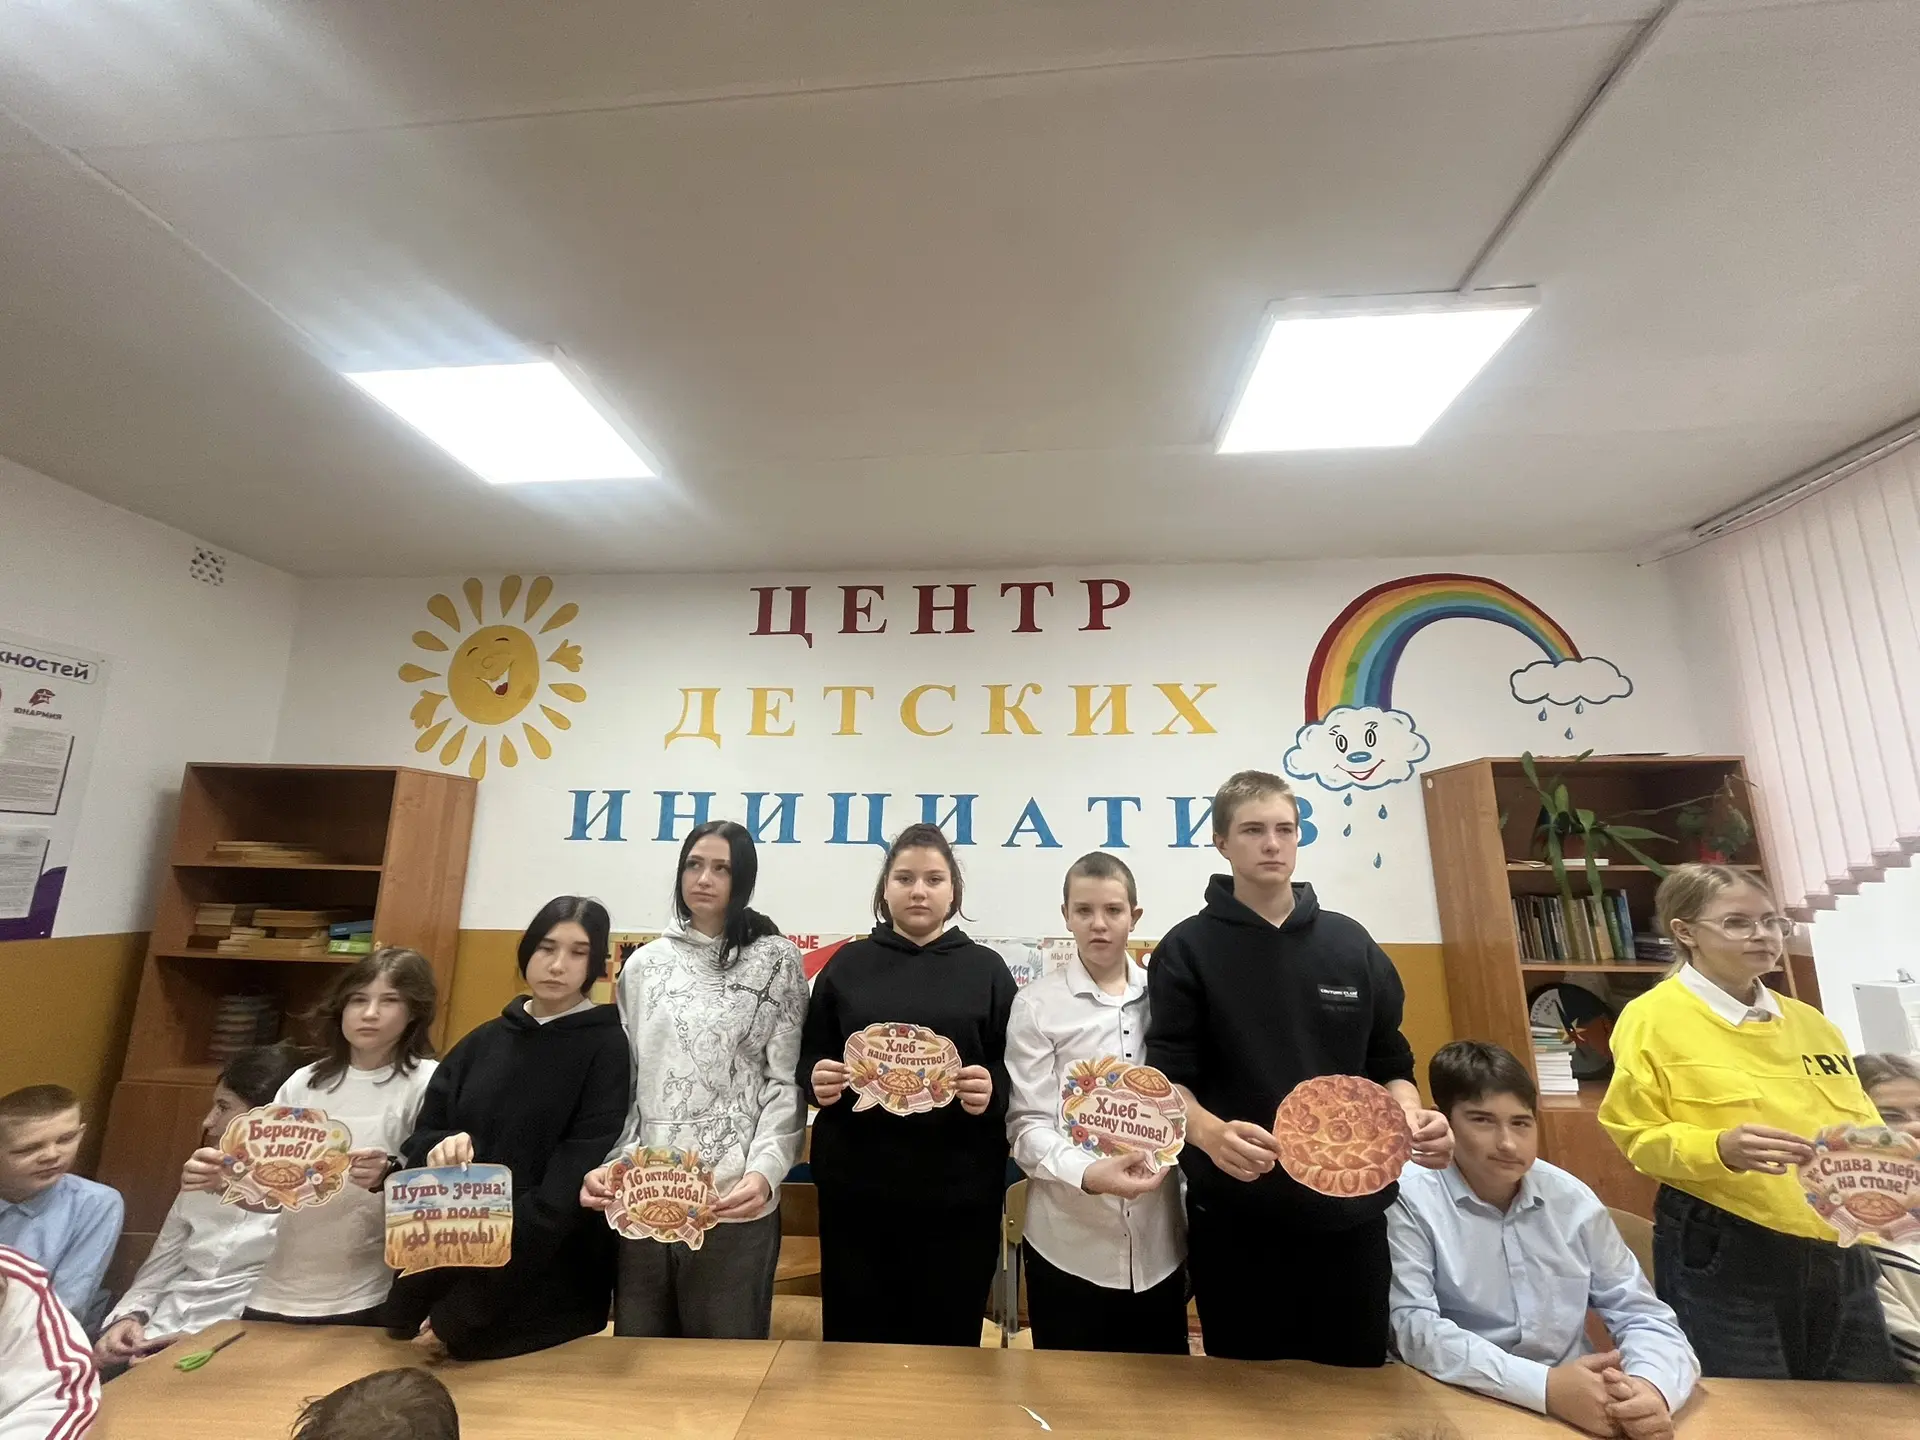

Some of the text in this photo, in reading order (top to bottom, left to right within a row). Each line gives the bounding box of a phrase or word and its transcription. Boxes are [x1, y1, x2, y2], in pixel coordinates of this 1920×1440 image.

[749, 579, 1131, 648] ЦЕНТР
[14, 707, 62, 720] ЮНАРМИЯ
[665, 683, 1218, 749] ДЕТСКИХ
[886, 1039, 916, 1053] Хлеб
[867, 1048, 946, 1066] наше богатство!
[1096, 1096, 1138, 1119] Хлеб
[248, 1119, 327, 1143] Берегите
[1079, 1112, 1168, 1144] всему голова!
[263, 1141, 313, 1160] хлеб!
[627, 1169, 643, 1188] 16
[645, 1168, 687, 1184] октября
[1820, 1157, 1920, 1185] Слава хлебу
[392, 1184, 449, 1203] Путь
[662, 1184, 706, 1204] хлеба!
[1837, 1175, 1910, 1195] на столе!
[413, 1206, 490, 1221] от поля
